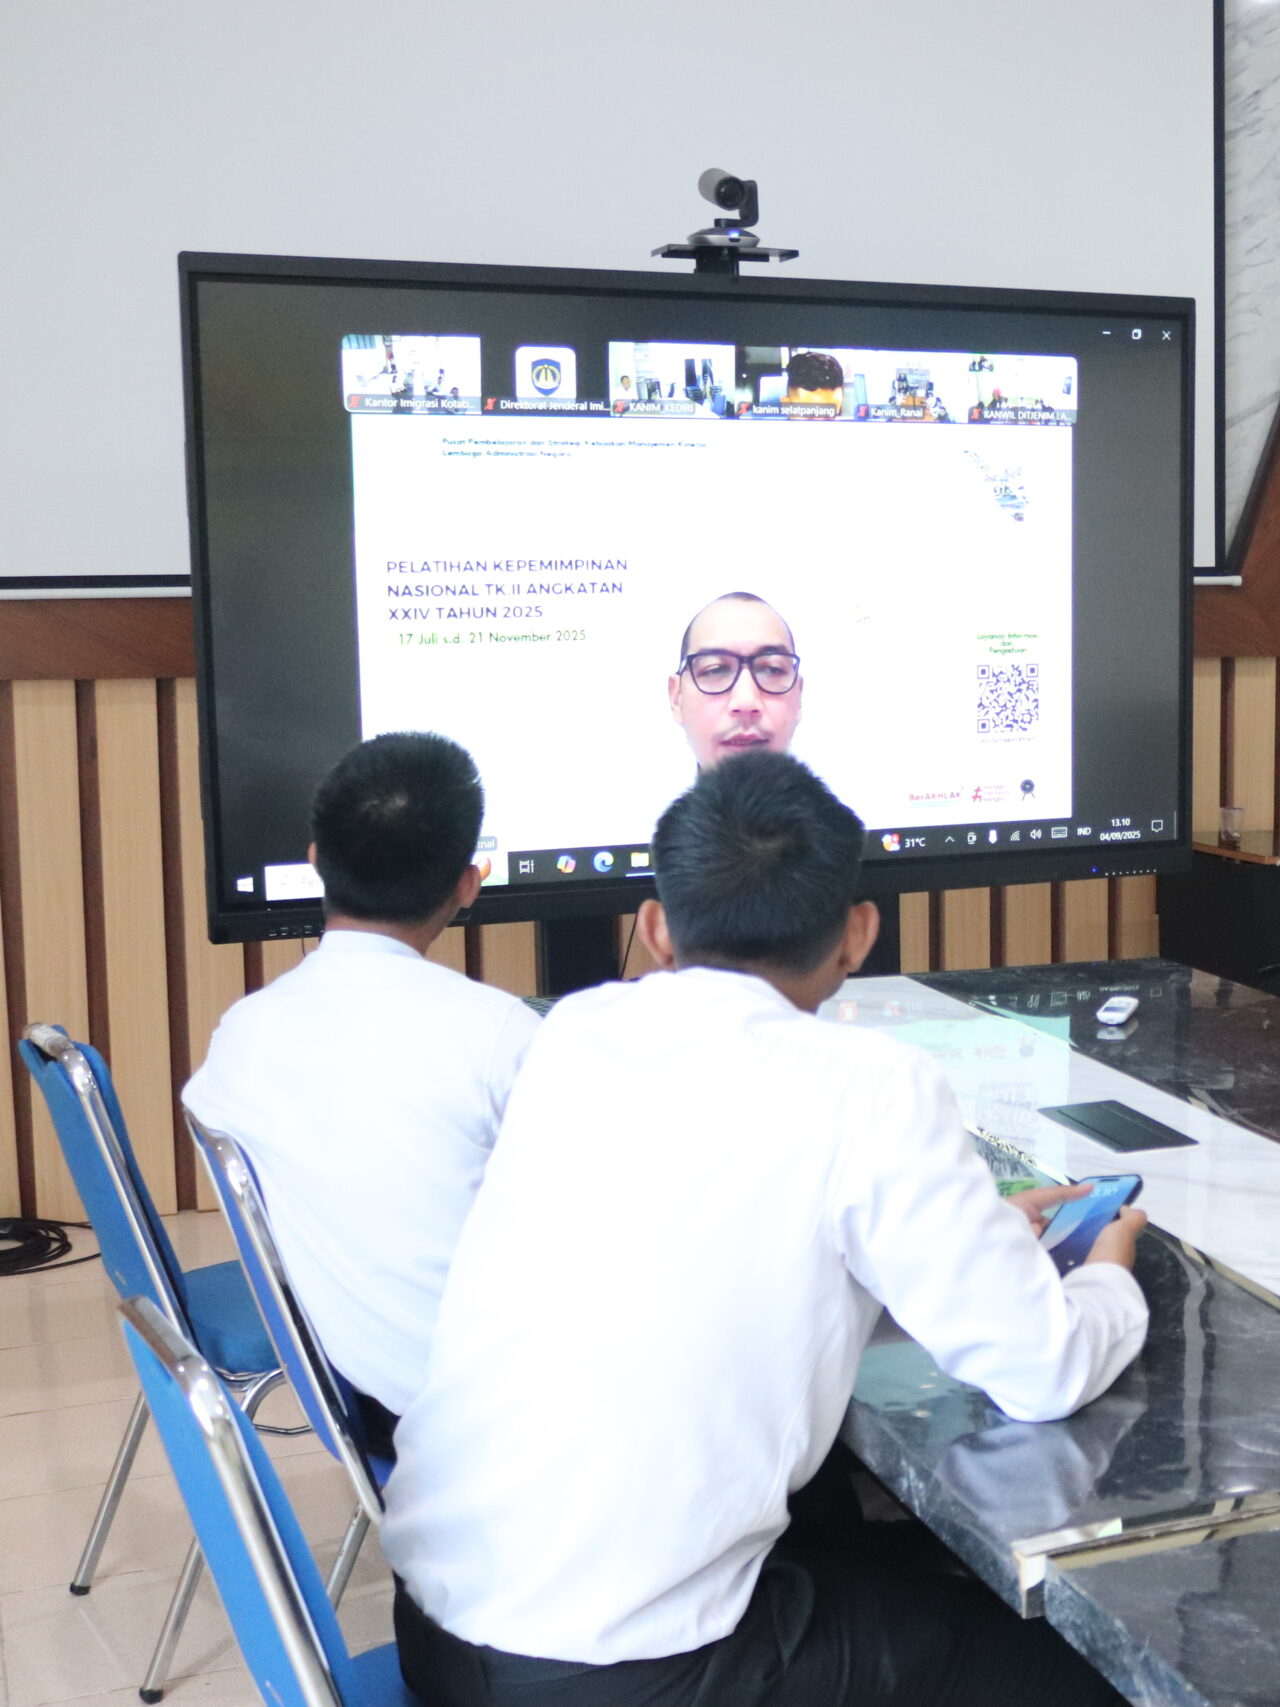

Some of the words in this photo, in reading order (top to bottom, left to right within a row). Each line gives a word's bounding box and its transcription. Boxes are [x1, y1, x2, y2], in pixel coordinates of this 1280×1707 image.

[365, 398, 397, 408] Kantor
[400, 398, 438, 409] Imigrasi
[500, 400, 544, 410] Direktorat
[549, 400, 587, 411] Jenderal
[752, 405, 779, 414] kanim
[781, 405, 835, 418] selatpanjang
[984, 410, 1016, 419] KANWIL
[386, 560, 488, 574] PELATIHAN
[493, 559, 628, 572] KEPEMIMPINAN
[387, 584, 480, 598] NASIONAL
[526, 582, 624, 595] ANGKATAN
[388, 607, 430, 620] XXIV
[436, 606, 497, 619] TAHUN
[502, 606, 543, 618] 2025
[399, 633, 413, 645] 17
[418, 632, 438, 645] Juli
[469, 632, 483, 644] 21
[489, 632, 551, 643] November
[556, 630, 586, 642] 2025
[909, 791, 961, 801] BerAKHLAK
[1111, 818, 1131, 827] 13.10
[1077, 827, 1092, 836] IND
[1100, 831, 1141, 841] 04/09/2025
[904, 837, 926, 848] 31°C
